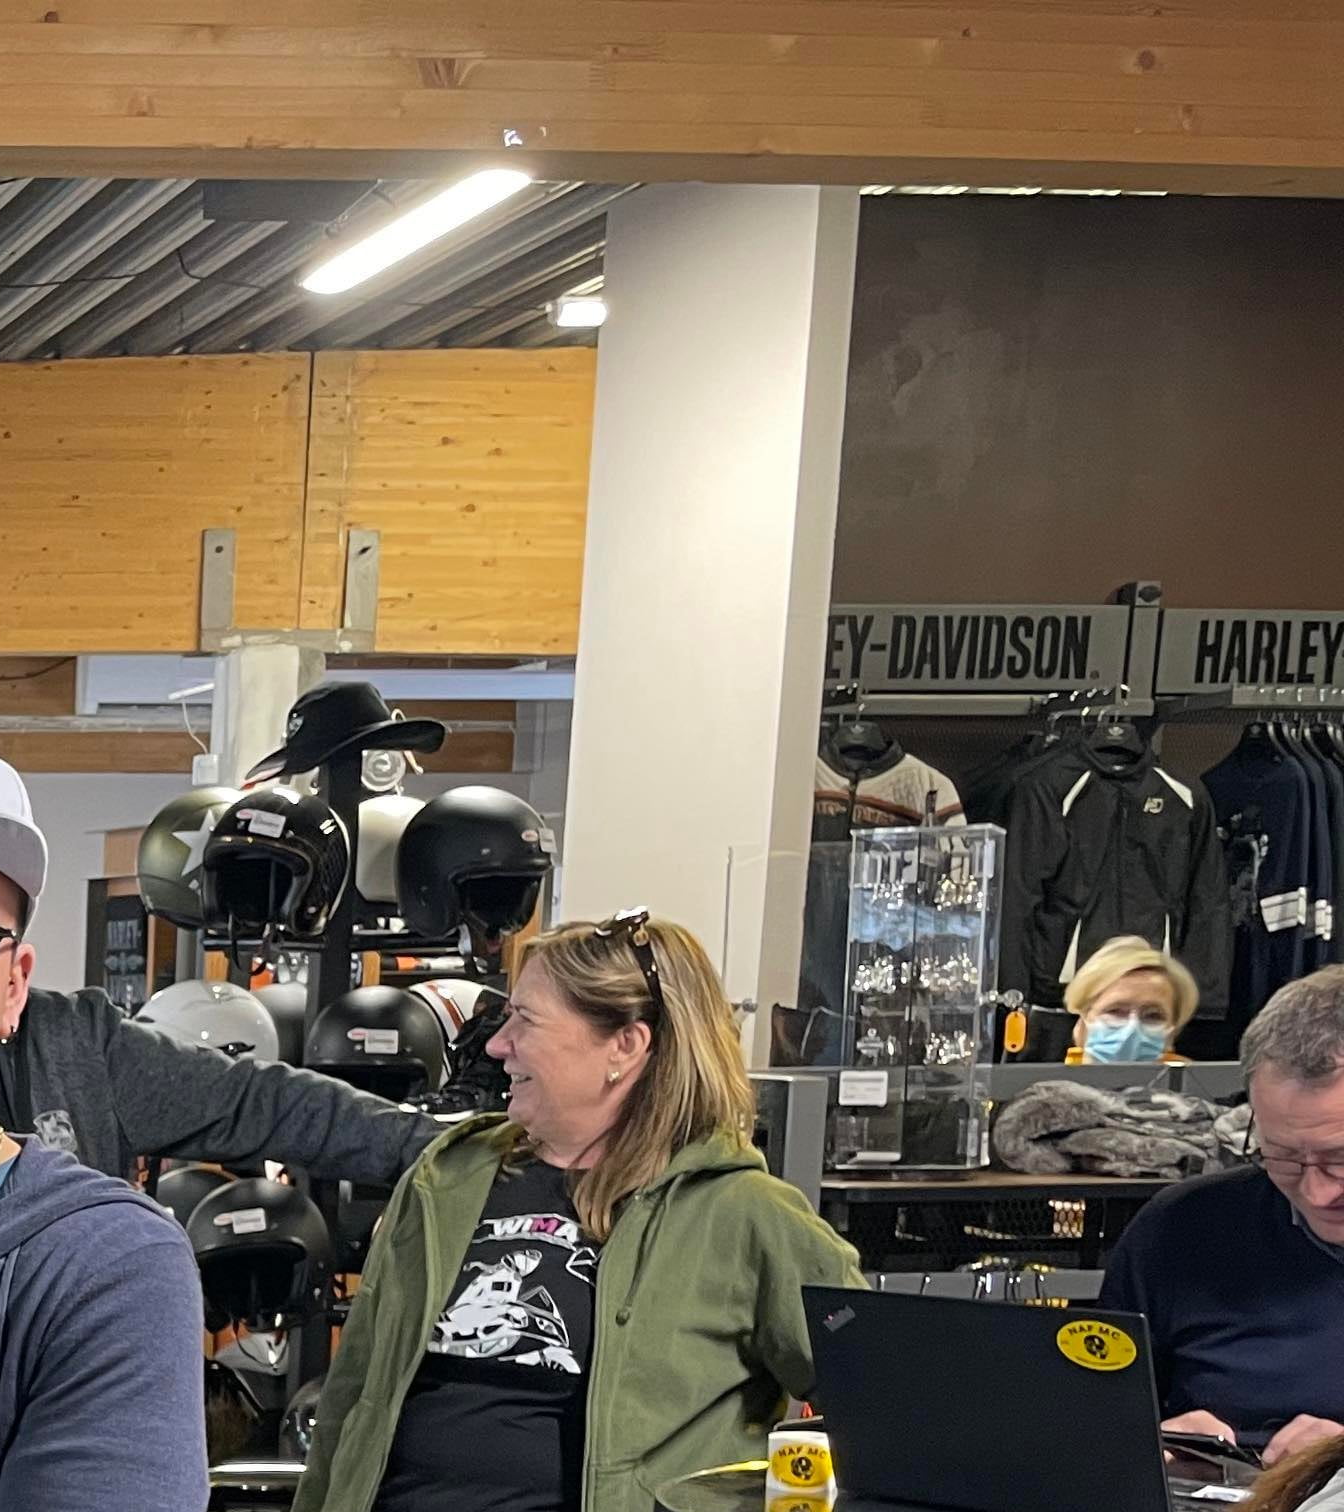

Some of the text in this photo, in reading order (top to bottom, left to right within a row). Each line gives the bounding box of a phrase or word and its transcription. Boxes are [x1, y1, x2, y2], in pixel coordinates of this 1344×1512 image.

[1194, 620, 1344, 684] HARLEY
[1067, 1324, 1121, 1341] NAF MC
